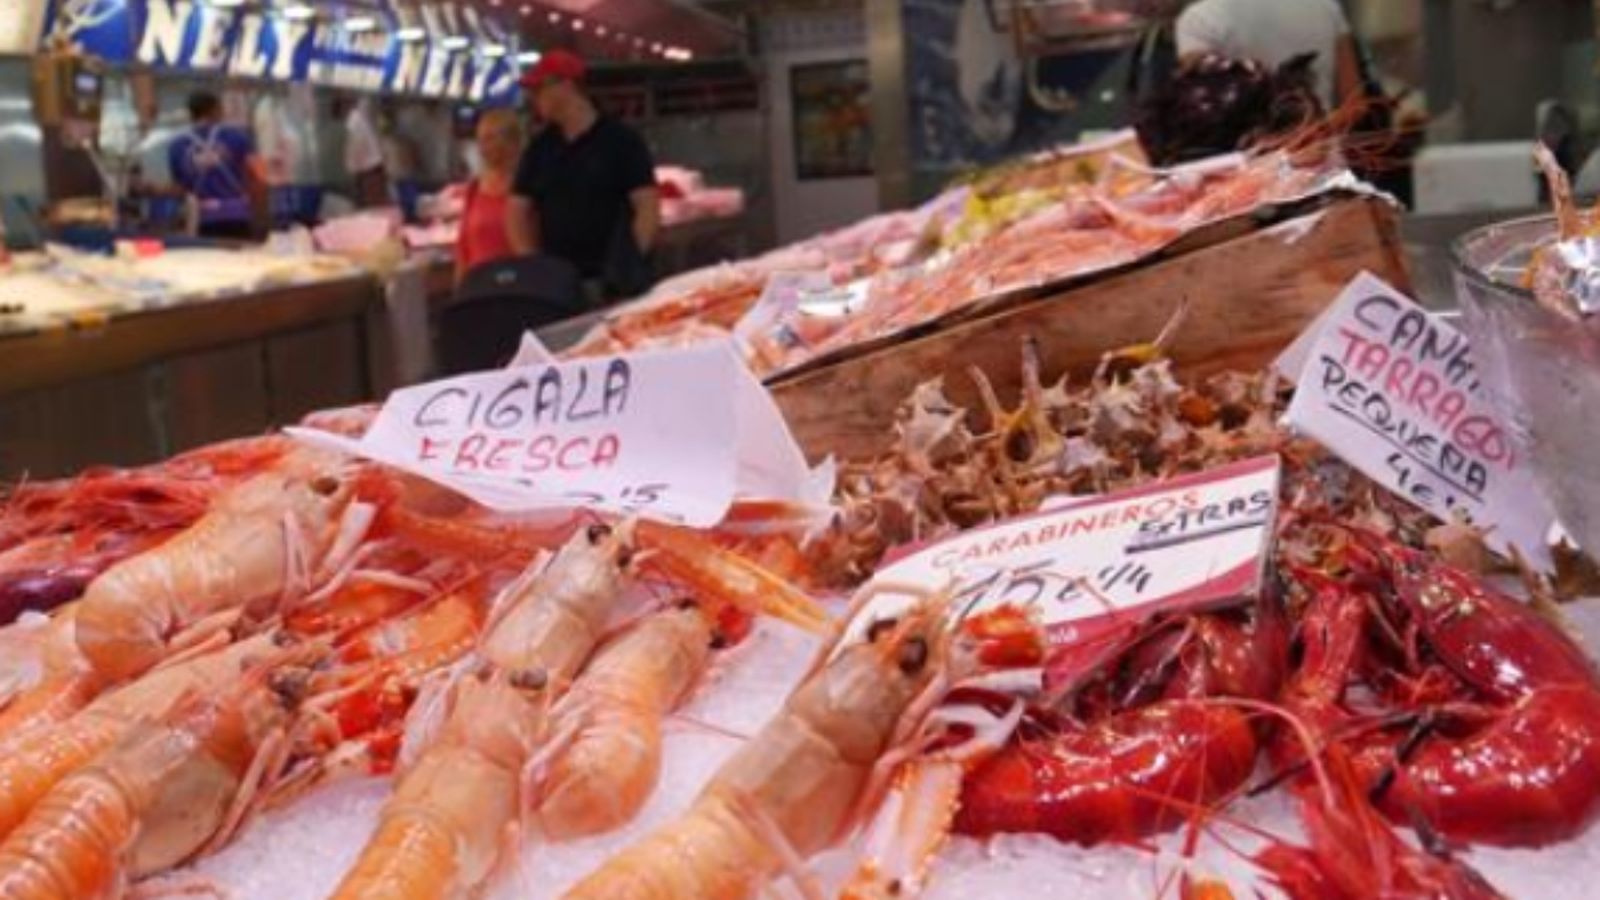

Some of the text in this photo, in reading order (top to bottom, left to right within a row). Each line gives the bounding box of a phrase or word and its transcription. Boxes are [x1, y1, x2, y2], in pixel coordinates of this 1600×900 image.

[138, 0, 309, 79] NELY
[414, 358, 631, 429] CIGALA
[418, 433, 620, 473] FRESCA
[930, 489, 1202, 569] CARABINEROS
